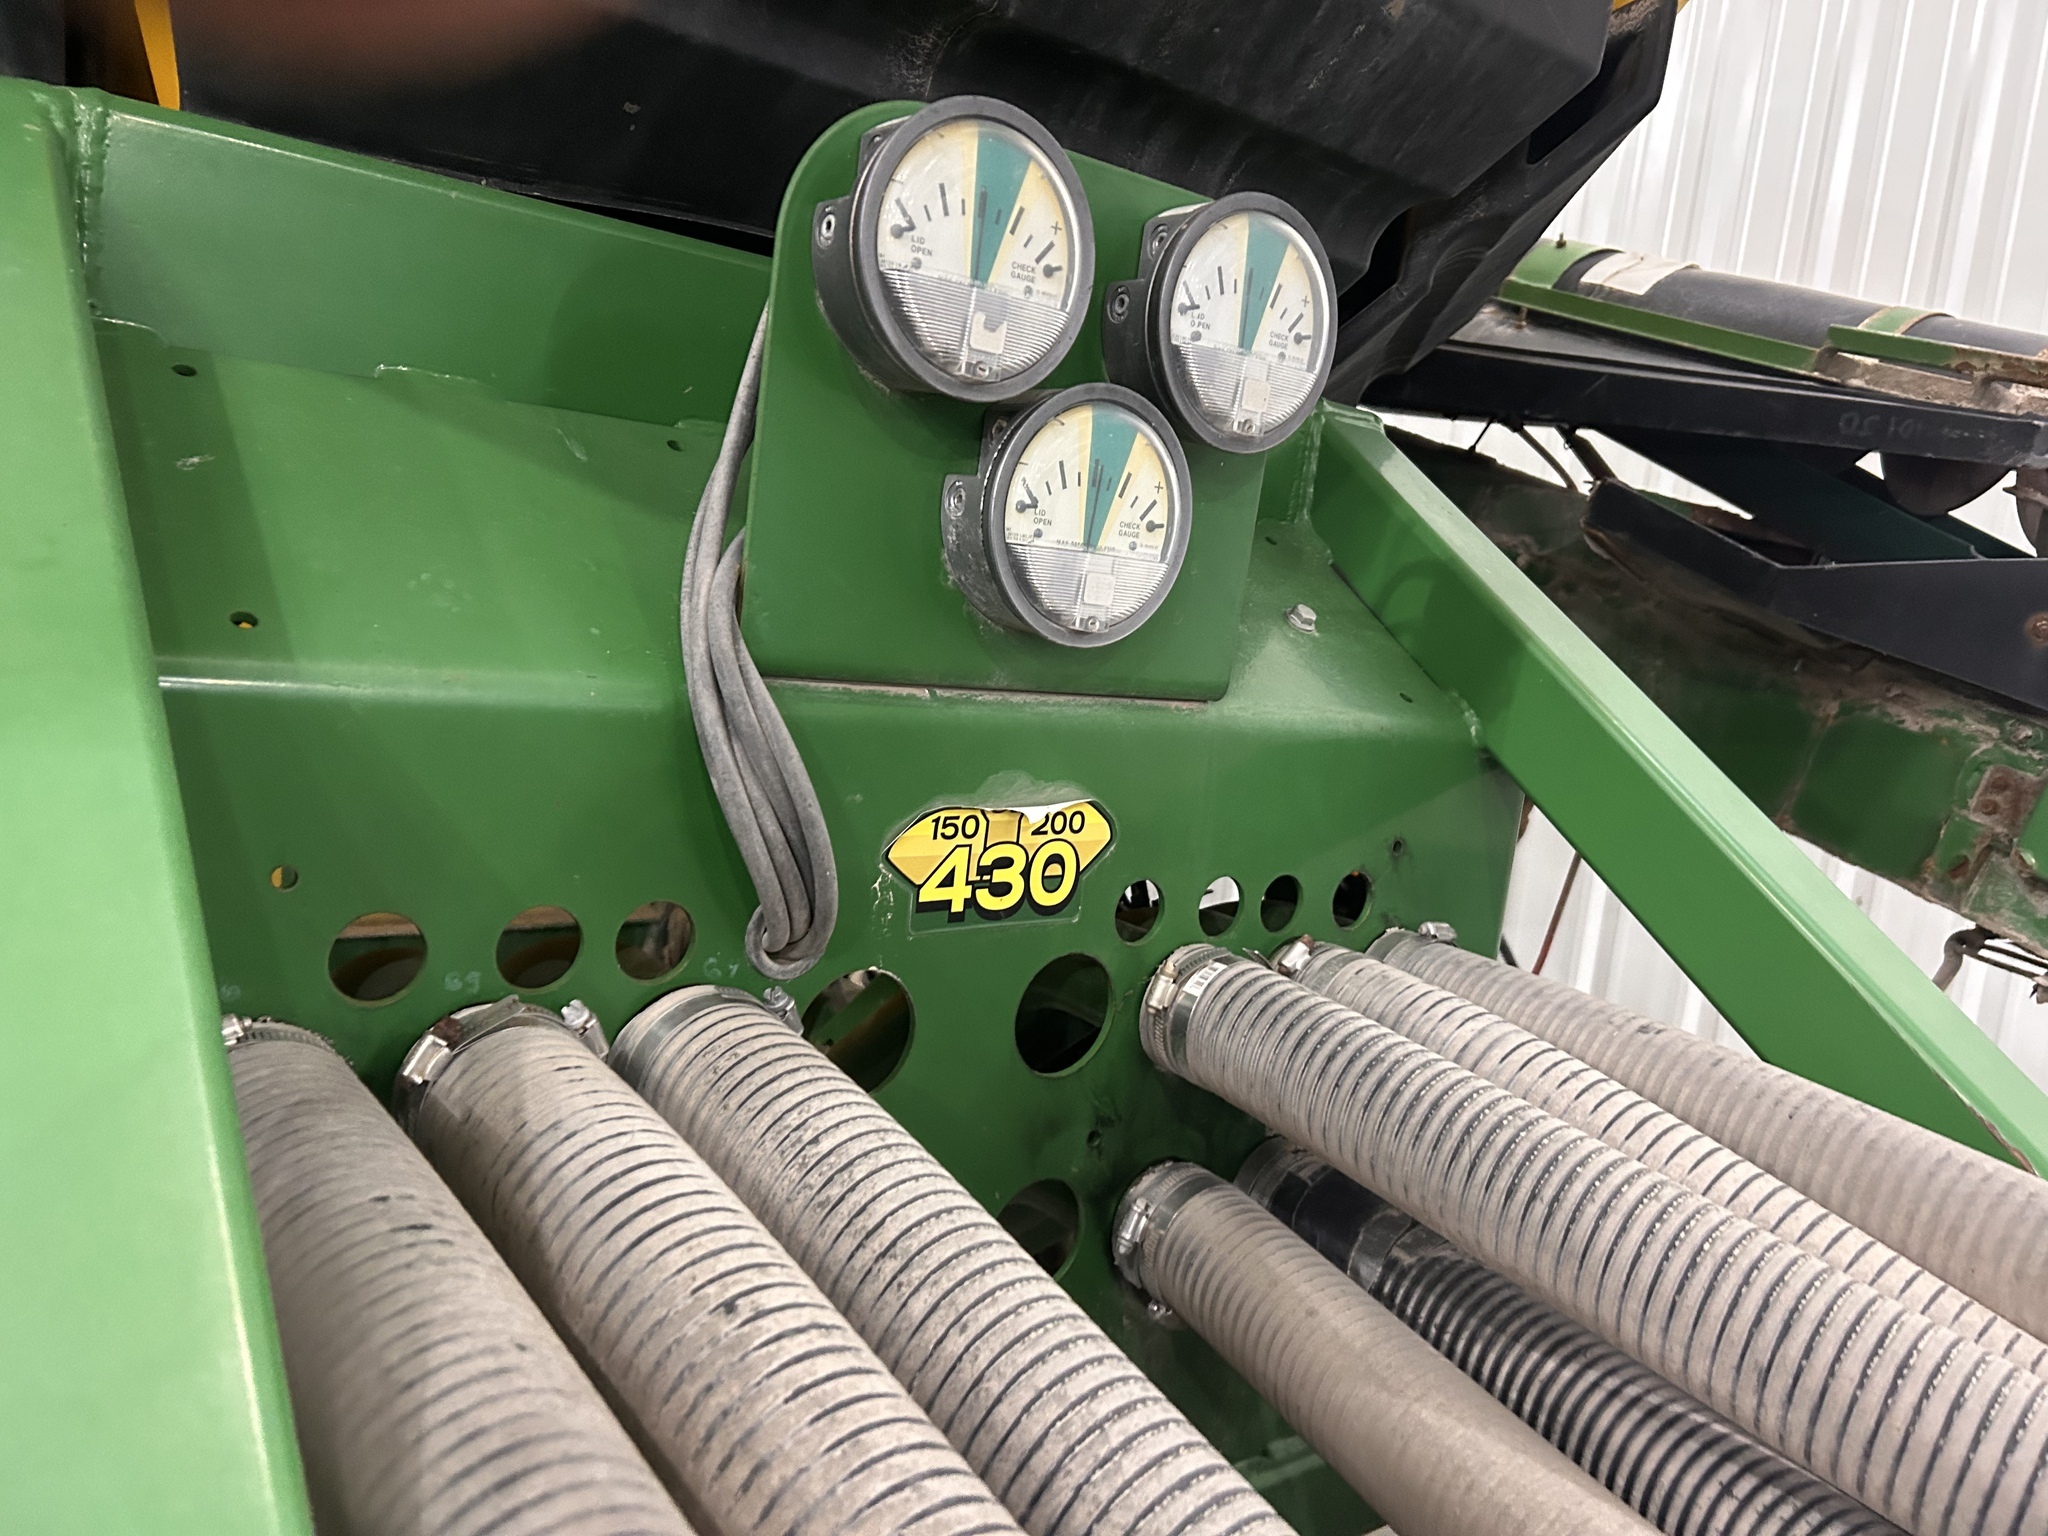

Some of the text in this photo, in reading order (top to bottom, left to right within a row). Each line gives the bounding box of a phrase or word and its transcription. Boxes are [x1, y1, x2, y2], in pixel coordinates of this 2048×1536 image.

[911, 235, 926, 245] LID
[911, 244, 933, 257] OPEN
[1011, 261, 1036, 274] CHECK
[1010, 270, 1036, 284] GAUGE
[1190, 320, 1211, 330] OPEN
[1269, 331, 1289, 342] CHECK
[1268, 339, 1288, 350] GAUGE
[1034, 507, 1046, 516] LID
[1033, 516, 1052, 526] OPEN
[1119, 521, 1141, 531] CHECK
[1118, 529, 1140, 539] GAUGE
[931, 810, 1085, 840] 150 200
[916, 838, 1080, 923] 430
